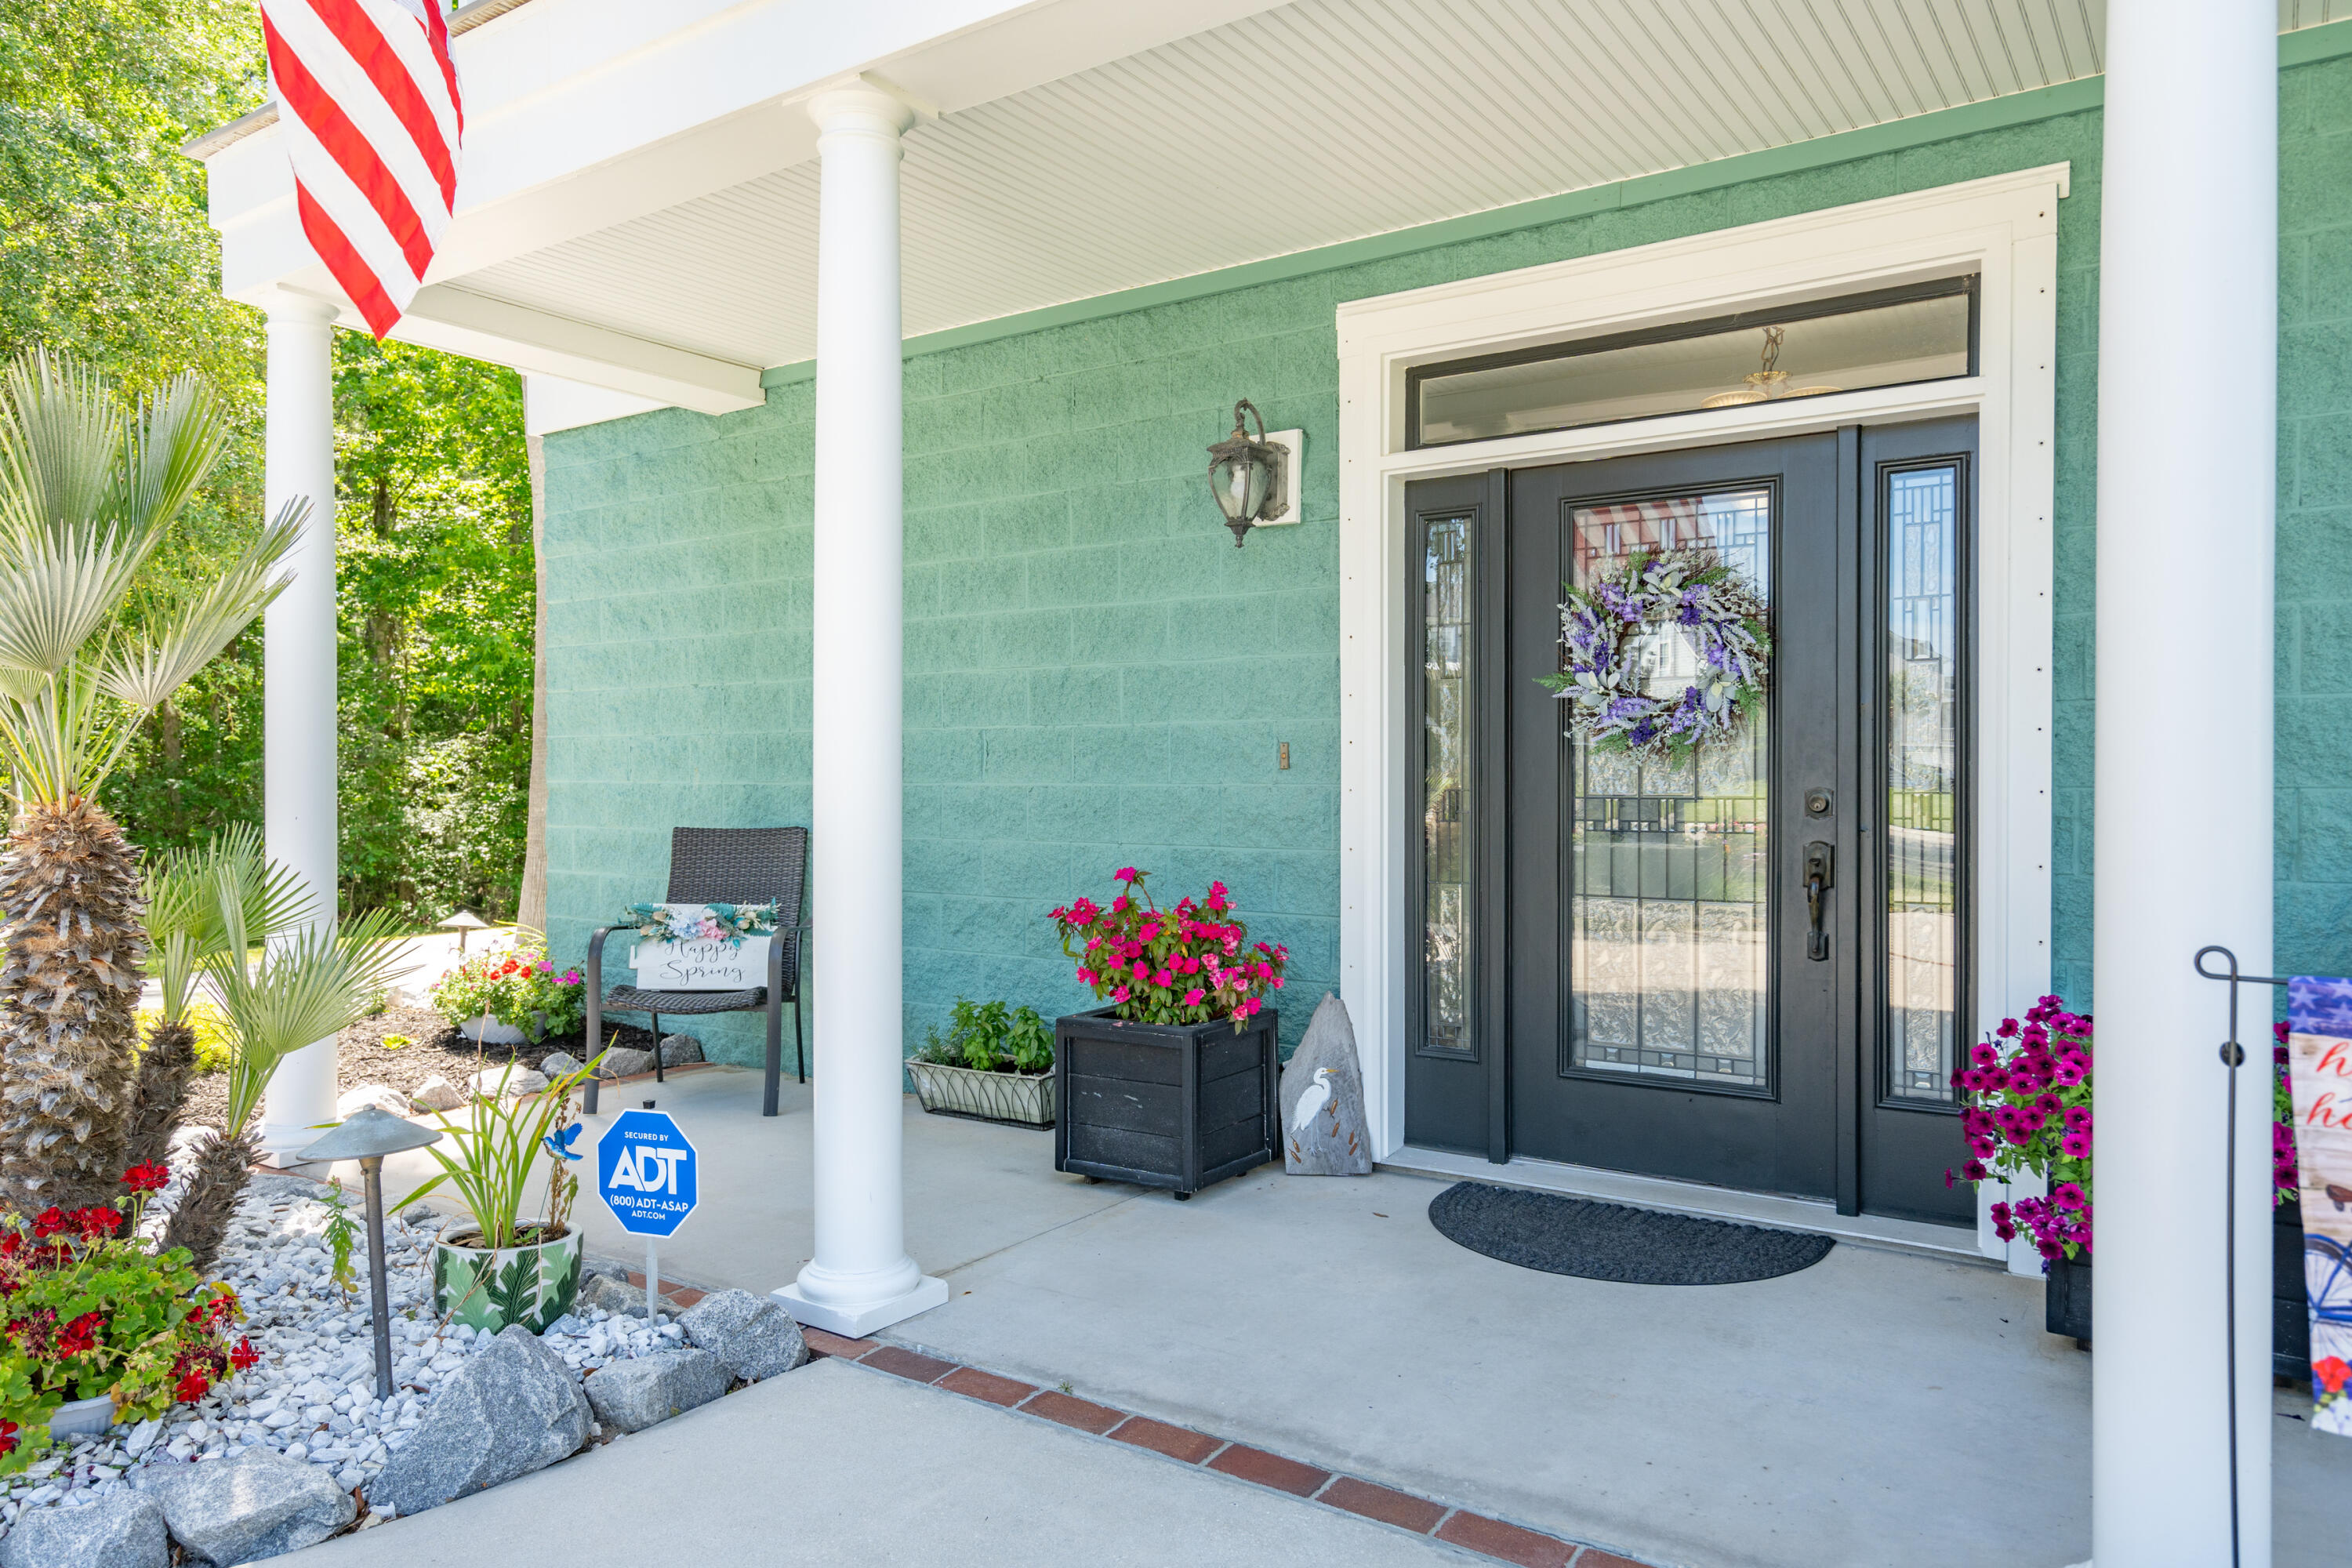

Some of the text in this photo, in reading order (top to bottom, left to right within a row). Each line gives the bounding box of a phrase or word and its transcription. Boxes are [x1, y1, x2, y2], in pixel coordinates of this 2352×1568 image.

[664, 940, 741, 963] Happy
[659, 960, 746, 986] Spring
[624, 1131, 658, 1141] SECURED
[608, 1145, 687, 1195] ADT
[610, 1194, 689, 1212] (800) ADT-ASAP
[631, 1210, 666, 1220] ADT.COM
